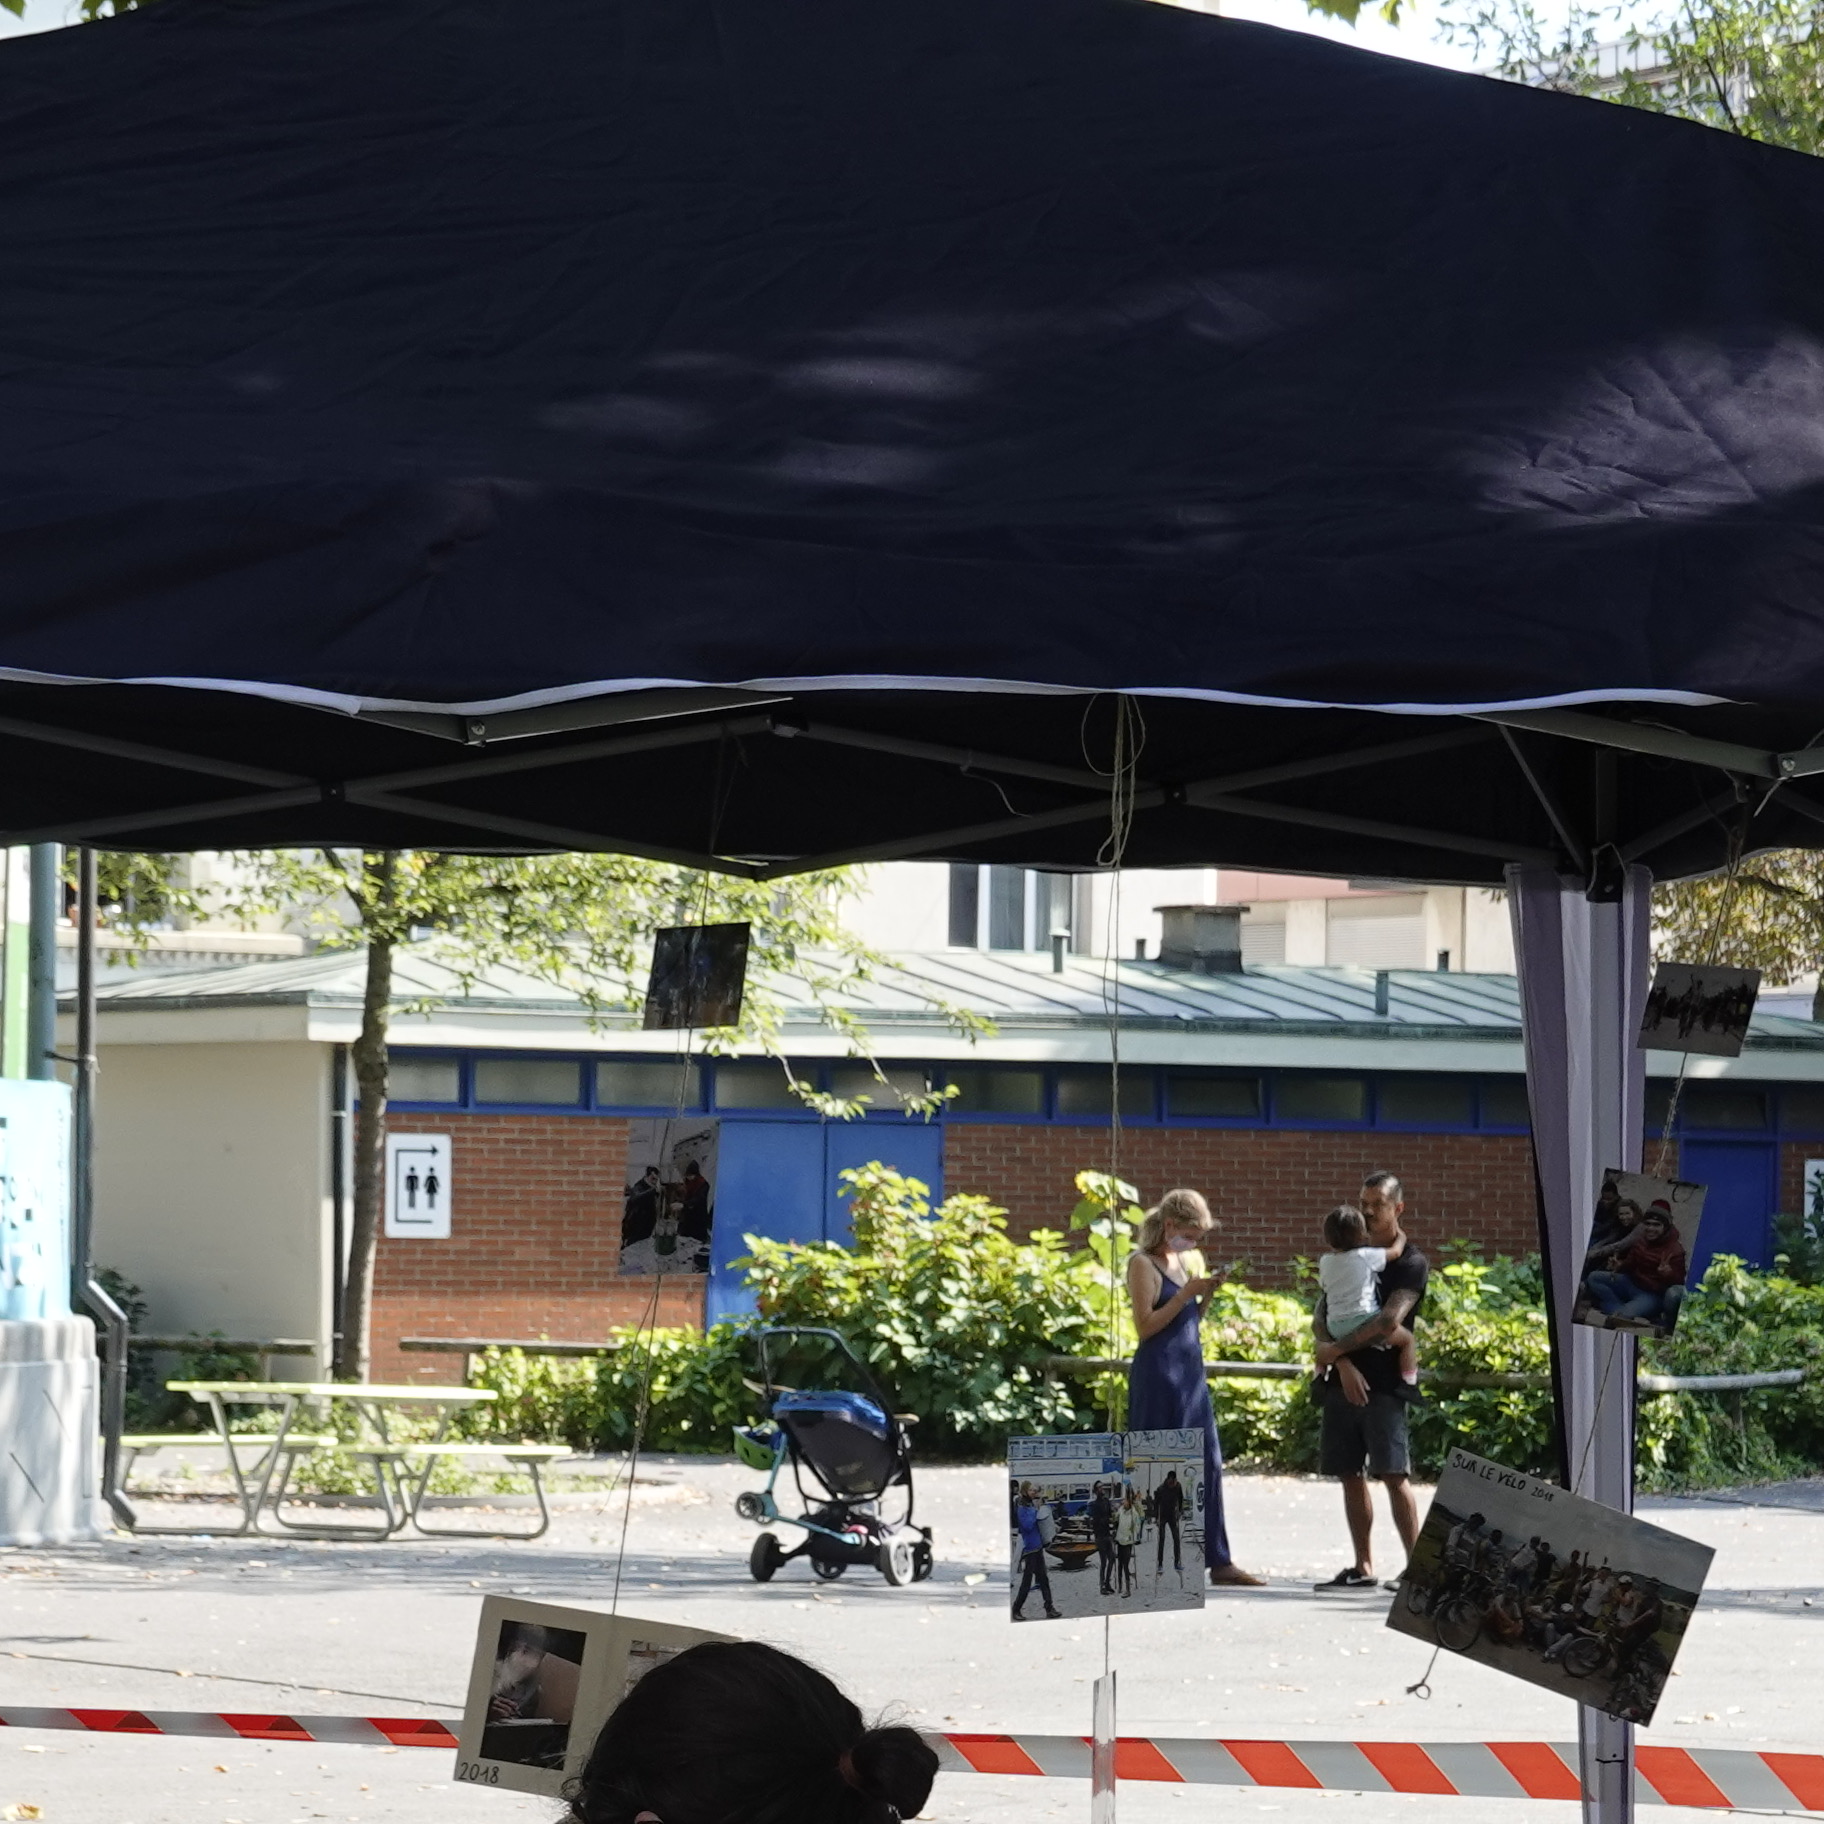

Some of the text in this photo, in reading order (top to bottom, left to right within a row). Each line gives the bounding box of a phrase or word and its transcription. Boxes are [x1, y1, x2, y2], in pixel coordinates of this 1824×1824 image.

[1452, 1454, 1478, 1474] SUR
[1480, 1465, 1495, 1481] LE
[458, 1762, 500, 1784] 2018
